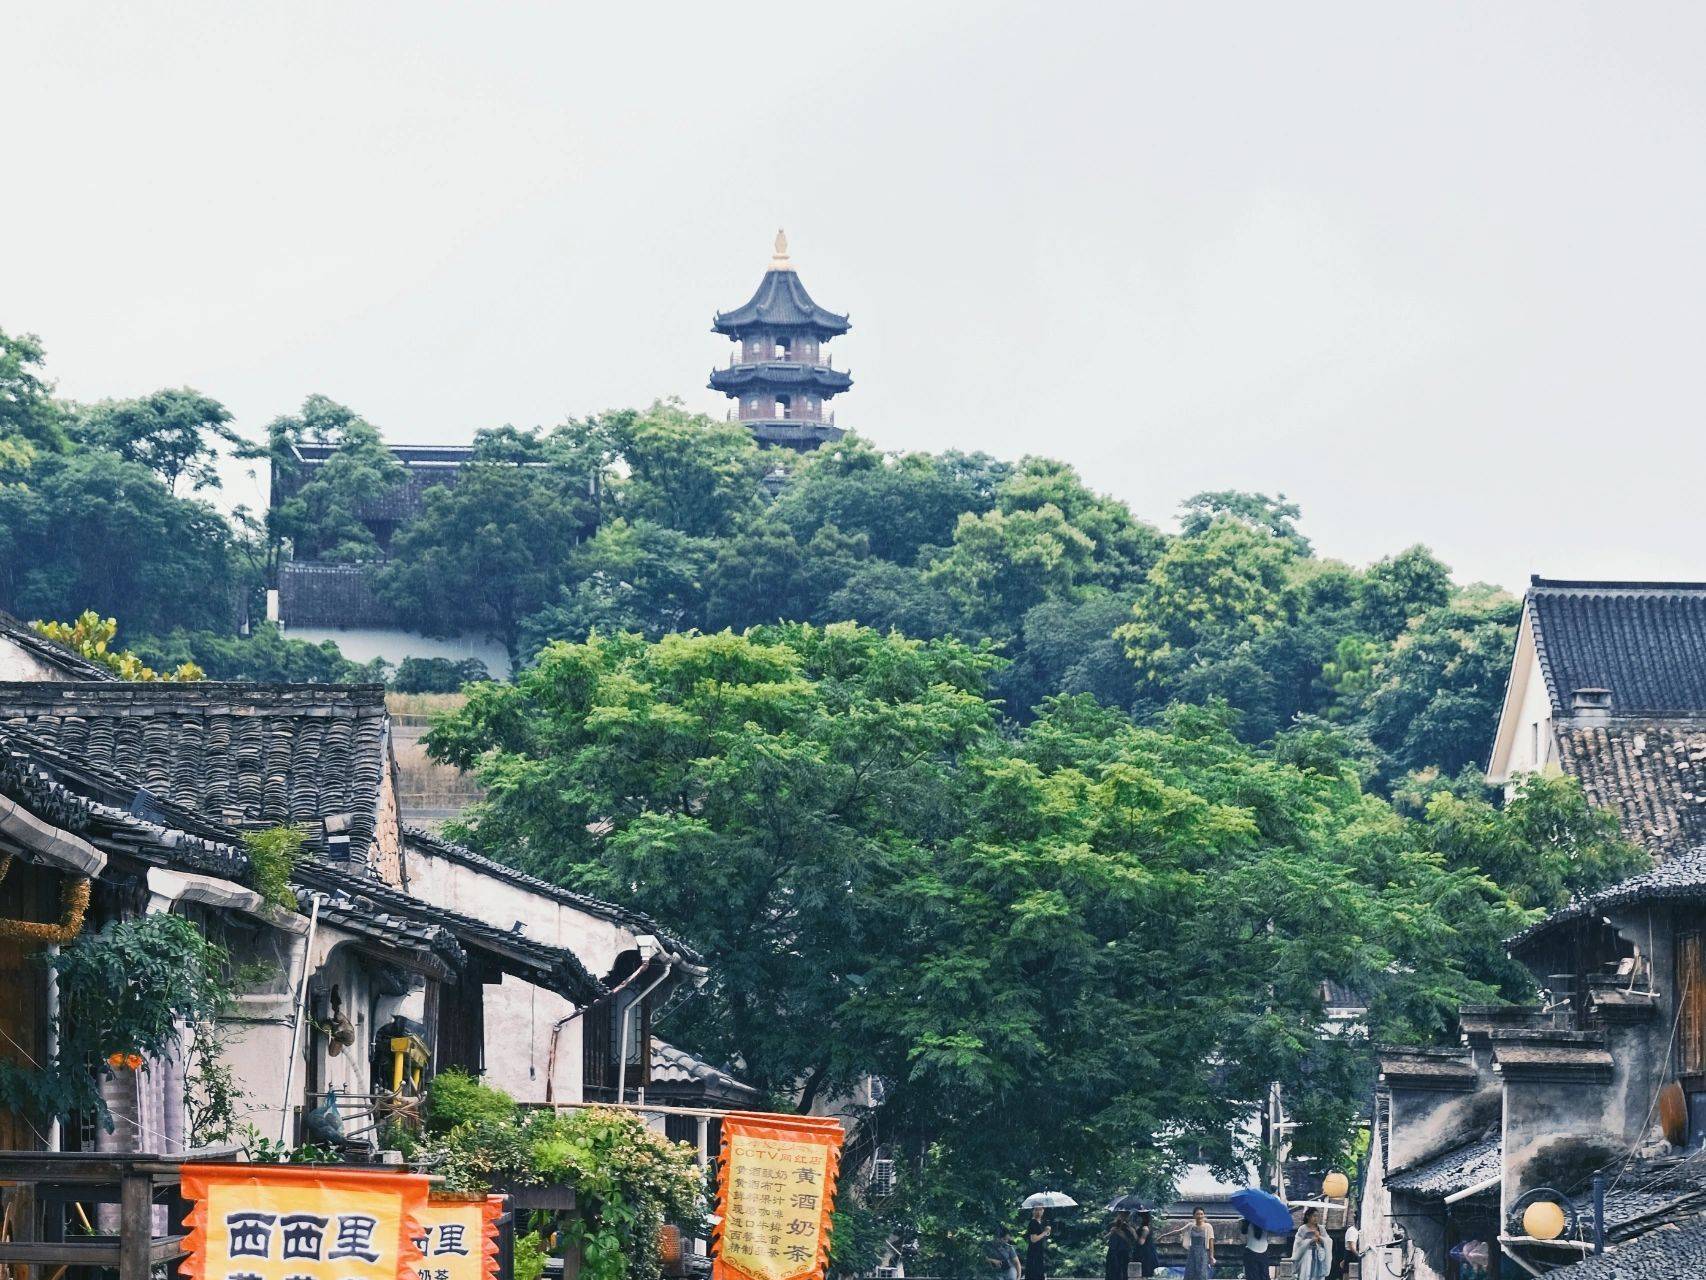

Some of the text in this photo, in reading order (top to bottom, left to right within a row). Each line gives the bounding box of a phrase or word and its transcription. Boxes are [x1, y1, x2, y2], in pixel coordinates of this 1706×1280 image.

[226, 1212, 380, 1263] 西西里
[783, 1167, 822, 1263] 黄酒奶茶
